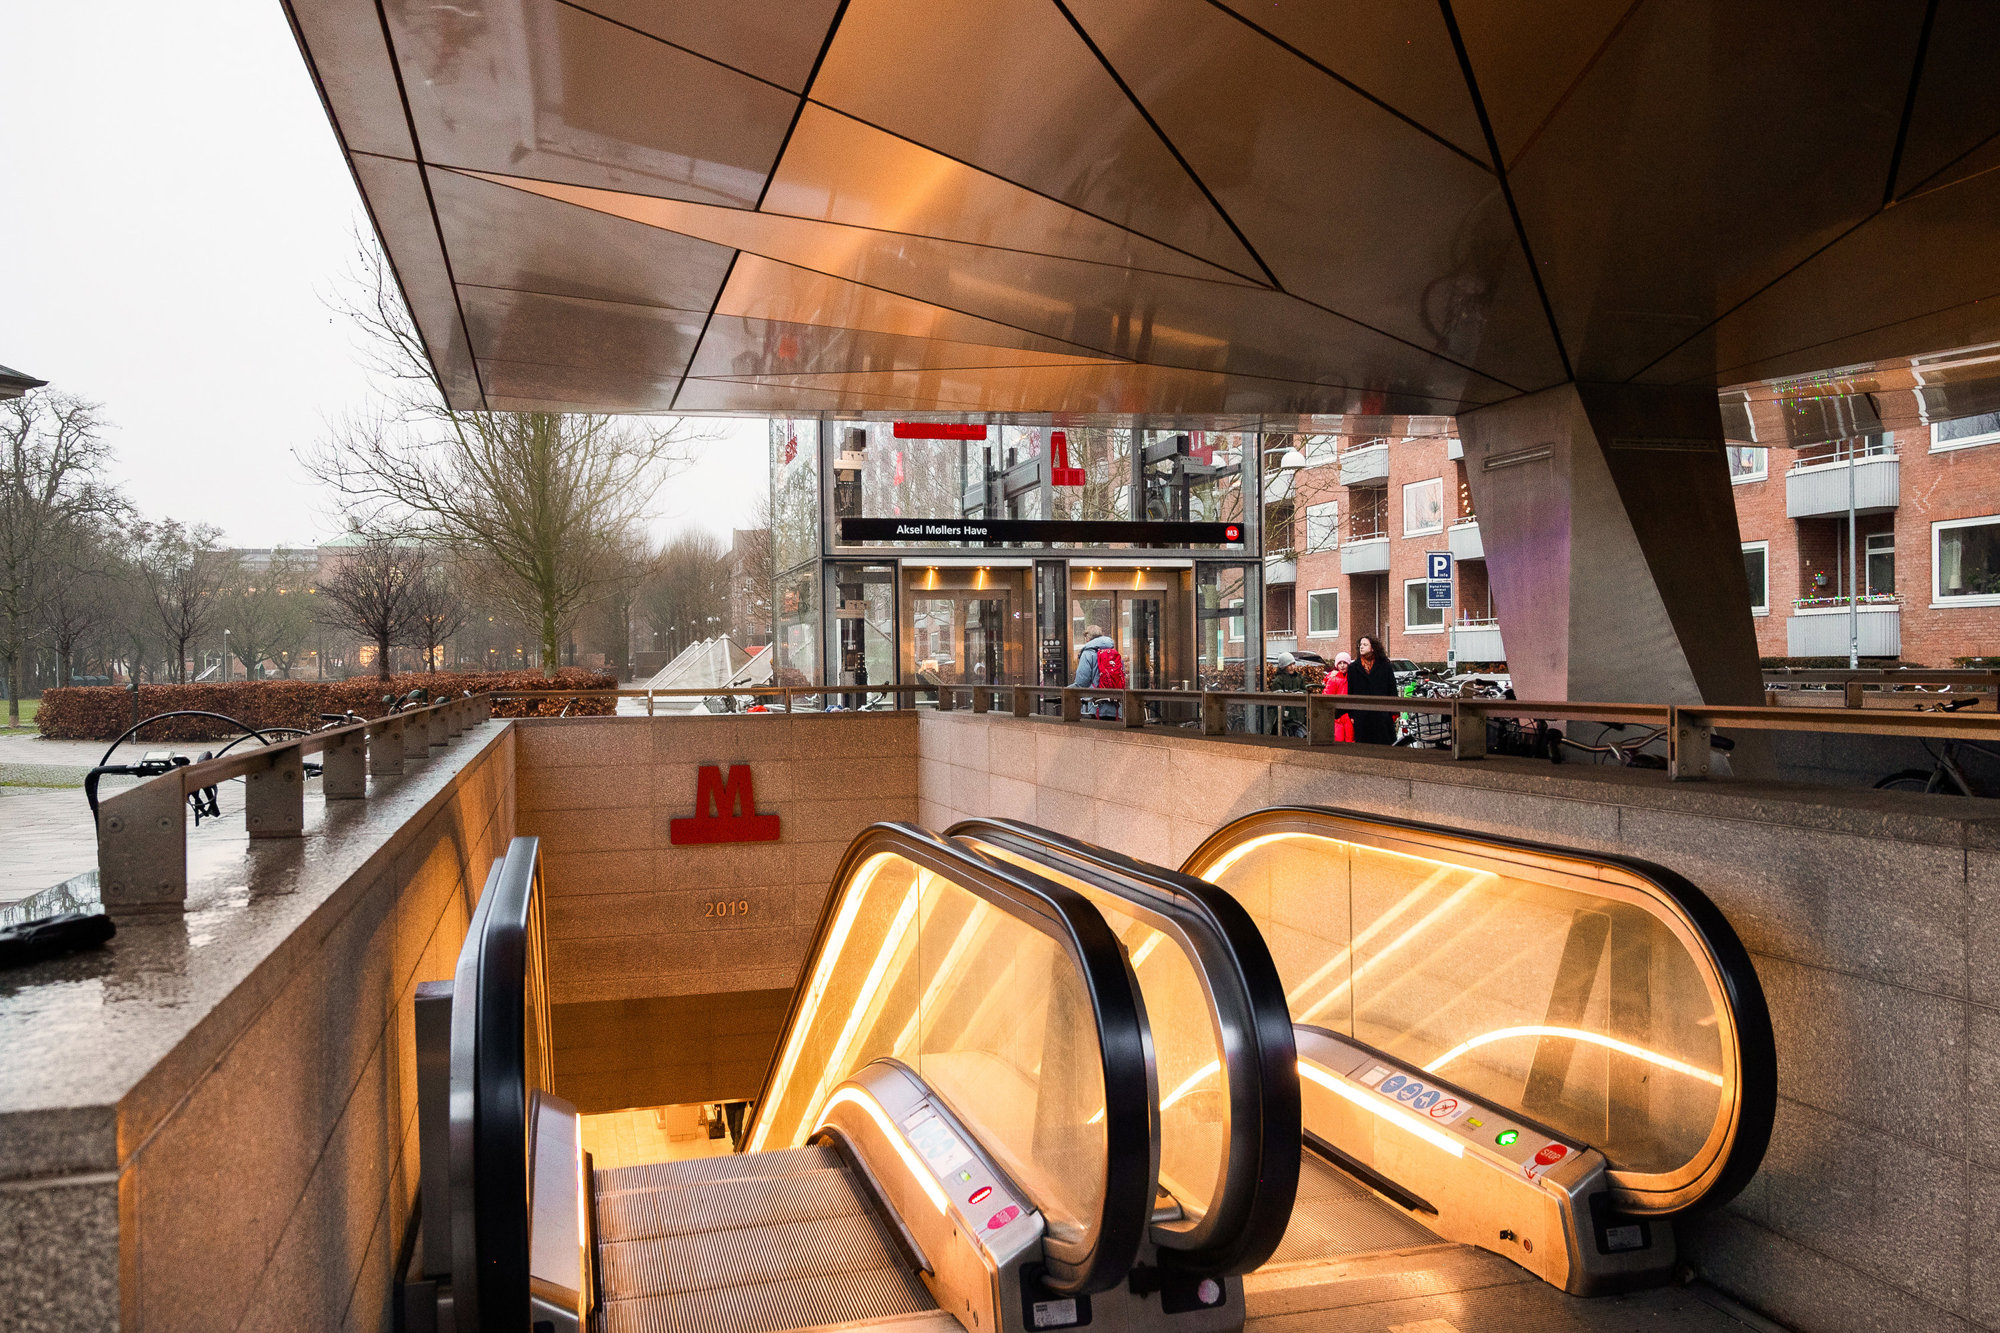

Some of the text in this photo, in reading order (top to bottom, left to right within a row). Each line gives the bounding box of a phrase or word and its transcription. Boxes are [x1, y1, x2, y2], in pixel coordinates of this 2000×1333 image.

[896, 525, 988, 535] Aksel Møllers Have
[1227, 529, 1238, 537] M3
[1433, 556, 1448, 577] P
[705, 900, 749, 918] 2019
[1540, 1148, 1562, 1161] STOP
